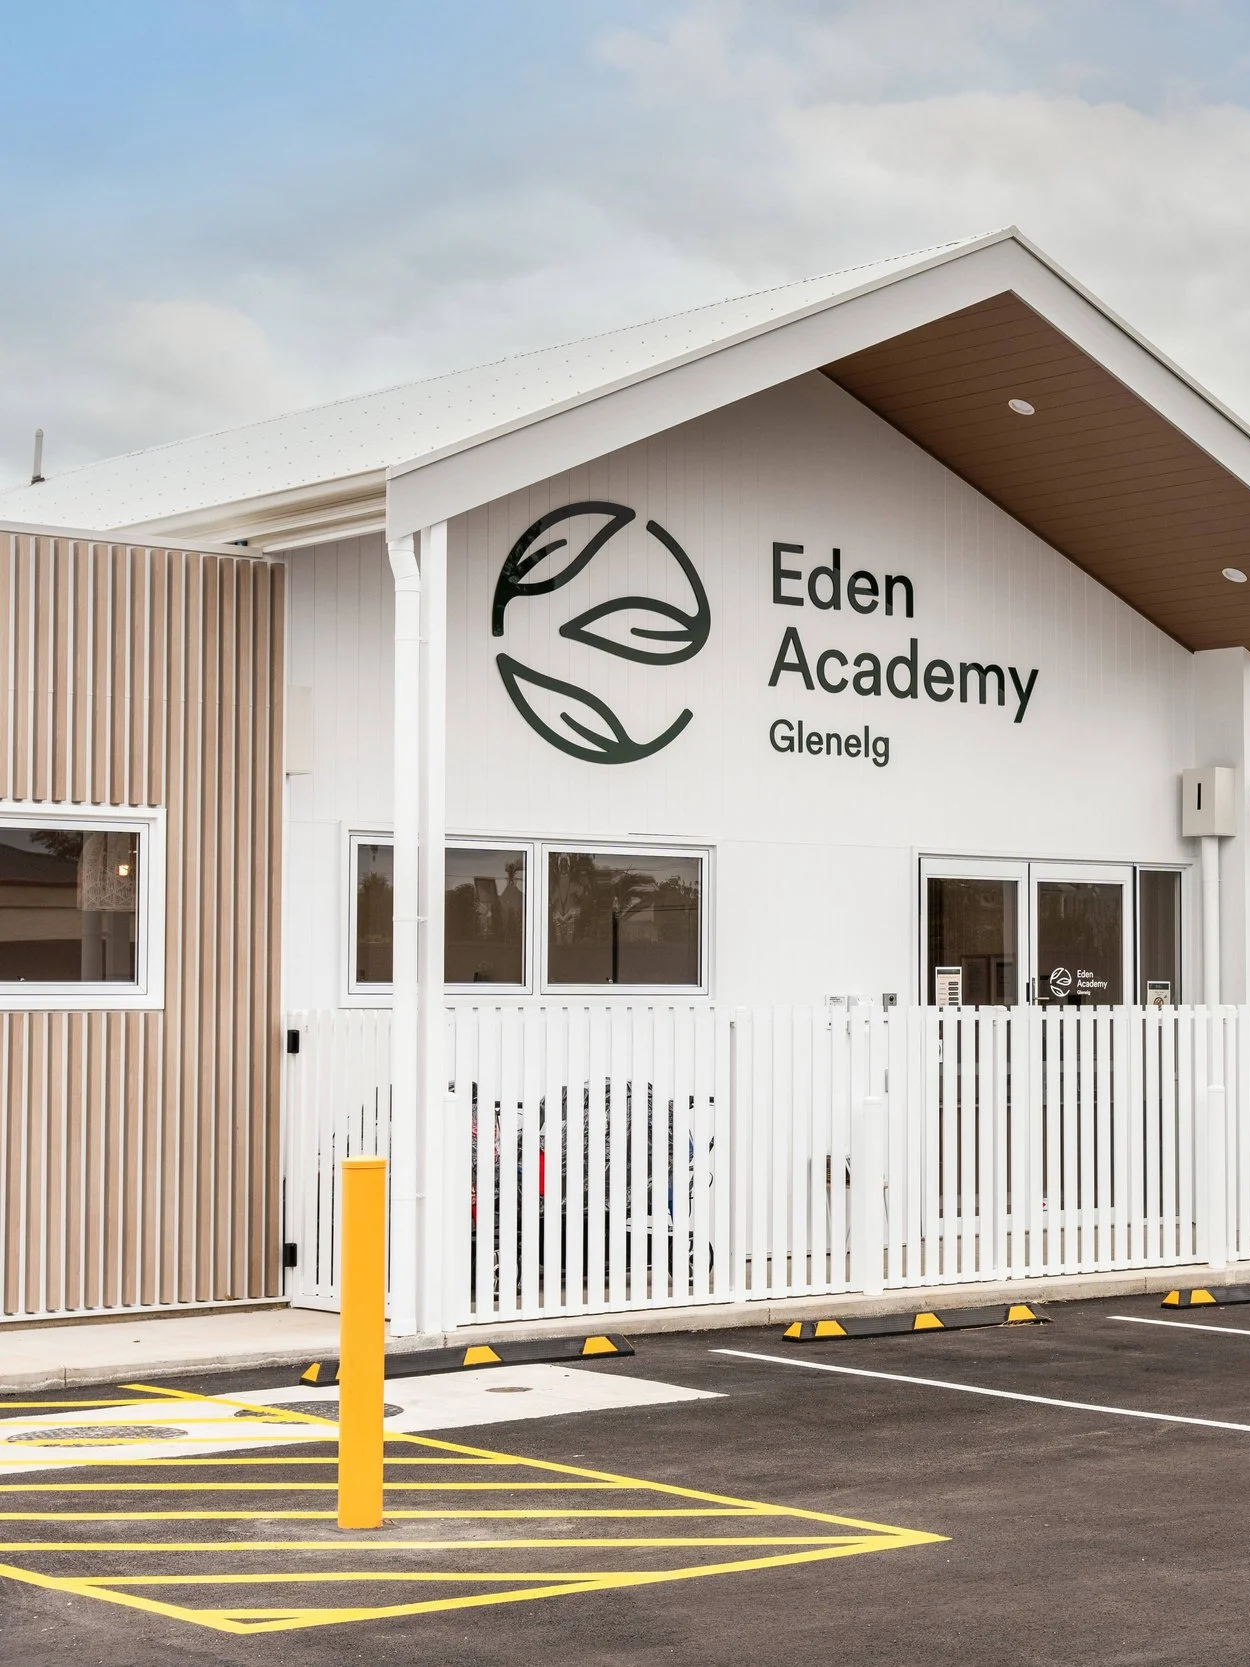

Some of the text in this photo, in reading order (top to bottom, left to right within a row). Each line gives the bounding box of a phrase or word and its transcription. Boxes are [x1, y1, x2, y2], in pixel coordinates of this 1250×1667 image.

[772, 541, 914, 619] Eden
[768, 626, 1040, 724] Academy
[769, 718, 890, 768] Glenelg
[1076, 969, 1094, 979] Eden
[1076, 979, 1108, 990] Academy
